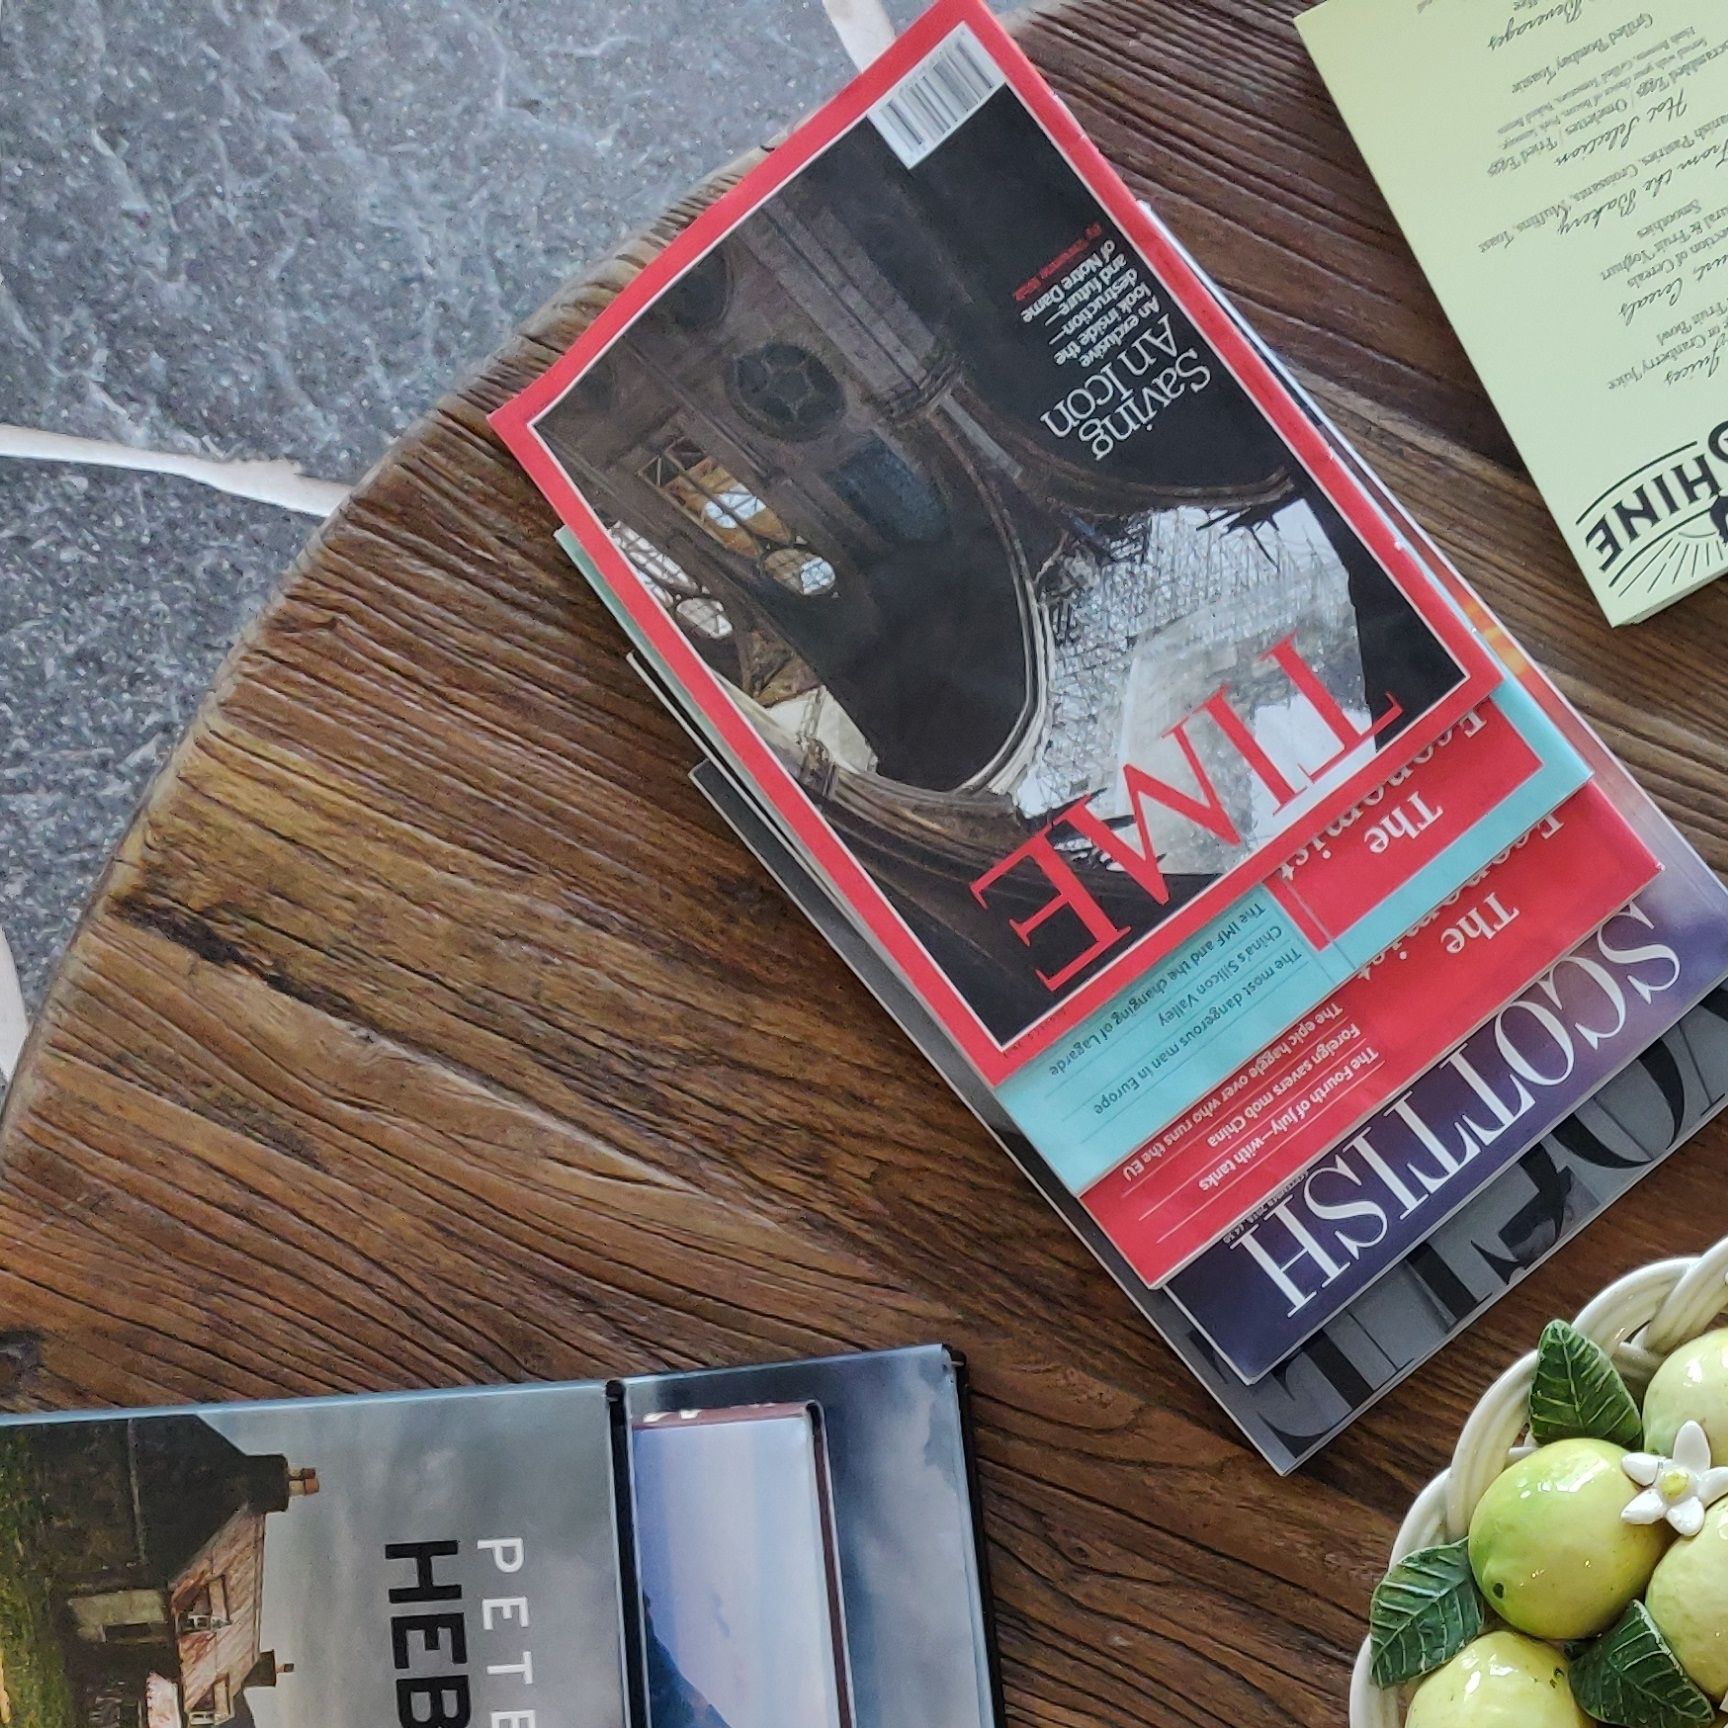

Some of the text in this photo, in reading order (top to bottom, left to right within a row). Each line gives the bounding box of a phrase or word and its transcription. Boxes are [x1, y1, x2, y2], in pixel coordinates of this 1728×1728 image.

[1641, 167, 1678, 198] the
[1634, 198, 1702, 241] Smoothies
[1095, 238, 1119, 261] of
[1097, 252, 1131, 284] and
[1673, 248, 1691, 266] of
[1058, 251, 1103, 292] Notre
[1625, 256, 1676, 291] Cereals
[1018, 283, 1065, 325] Dame
[1051, 281, 1152, 369] look inside the
[1690, 300, 1728, 328] Fruit
[1077, 295, 1163, 371] An exclusive
[1639, 331, 1707, 375] Cranberry
[1654, 318, 1694, 347] Bowl
[1038, 313, 1176, 440] An Icon
[1605, 366, 1643, 394] Juice
[1077, 346, 1214, 461] Saving
[965, 630, 1402, 994] TIME
[1361, 790, 1444, 856] The
[1213, 920, 1241, 947] IMF
[1237, 900, 1266, 927] The
[1440, 891, 1520, 955] The
[1166, 957, 1194, 983] the
[1189, 939, 1217, 965] and
[1195, 957, 1241, 998] Silicon
[1108, 973, 1171, 1028] changing
[1153, 986, 1200, 1029] Valley
[1088, 945, 1301, 1117] The most dangerous man in Europe
[1096, 1020, 1117, 1041] of
[1045, 1029, 1101, 1080] Lagarde
[1119, 1000, 1343, 1183] The epic haggle over who runs the EU
[1206, 1019, 1361, 1150] Foreign savers mob China
[1197, 1045, 1379, 1194] The Fourth of tanks
[1226, 900, 1687, 1318] SCOTTISH
